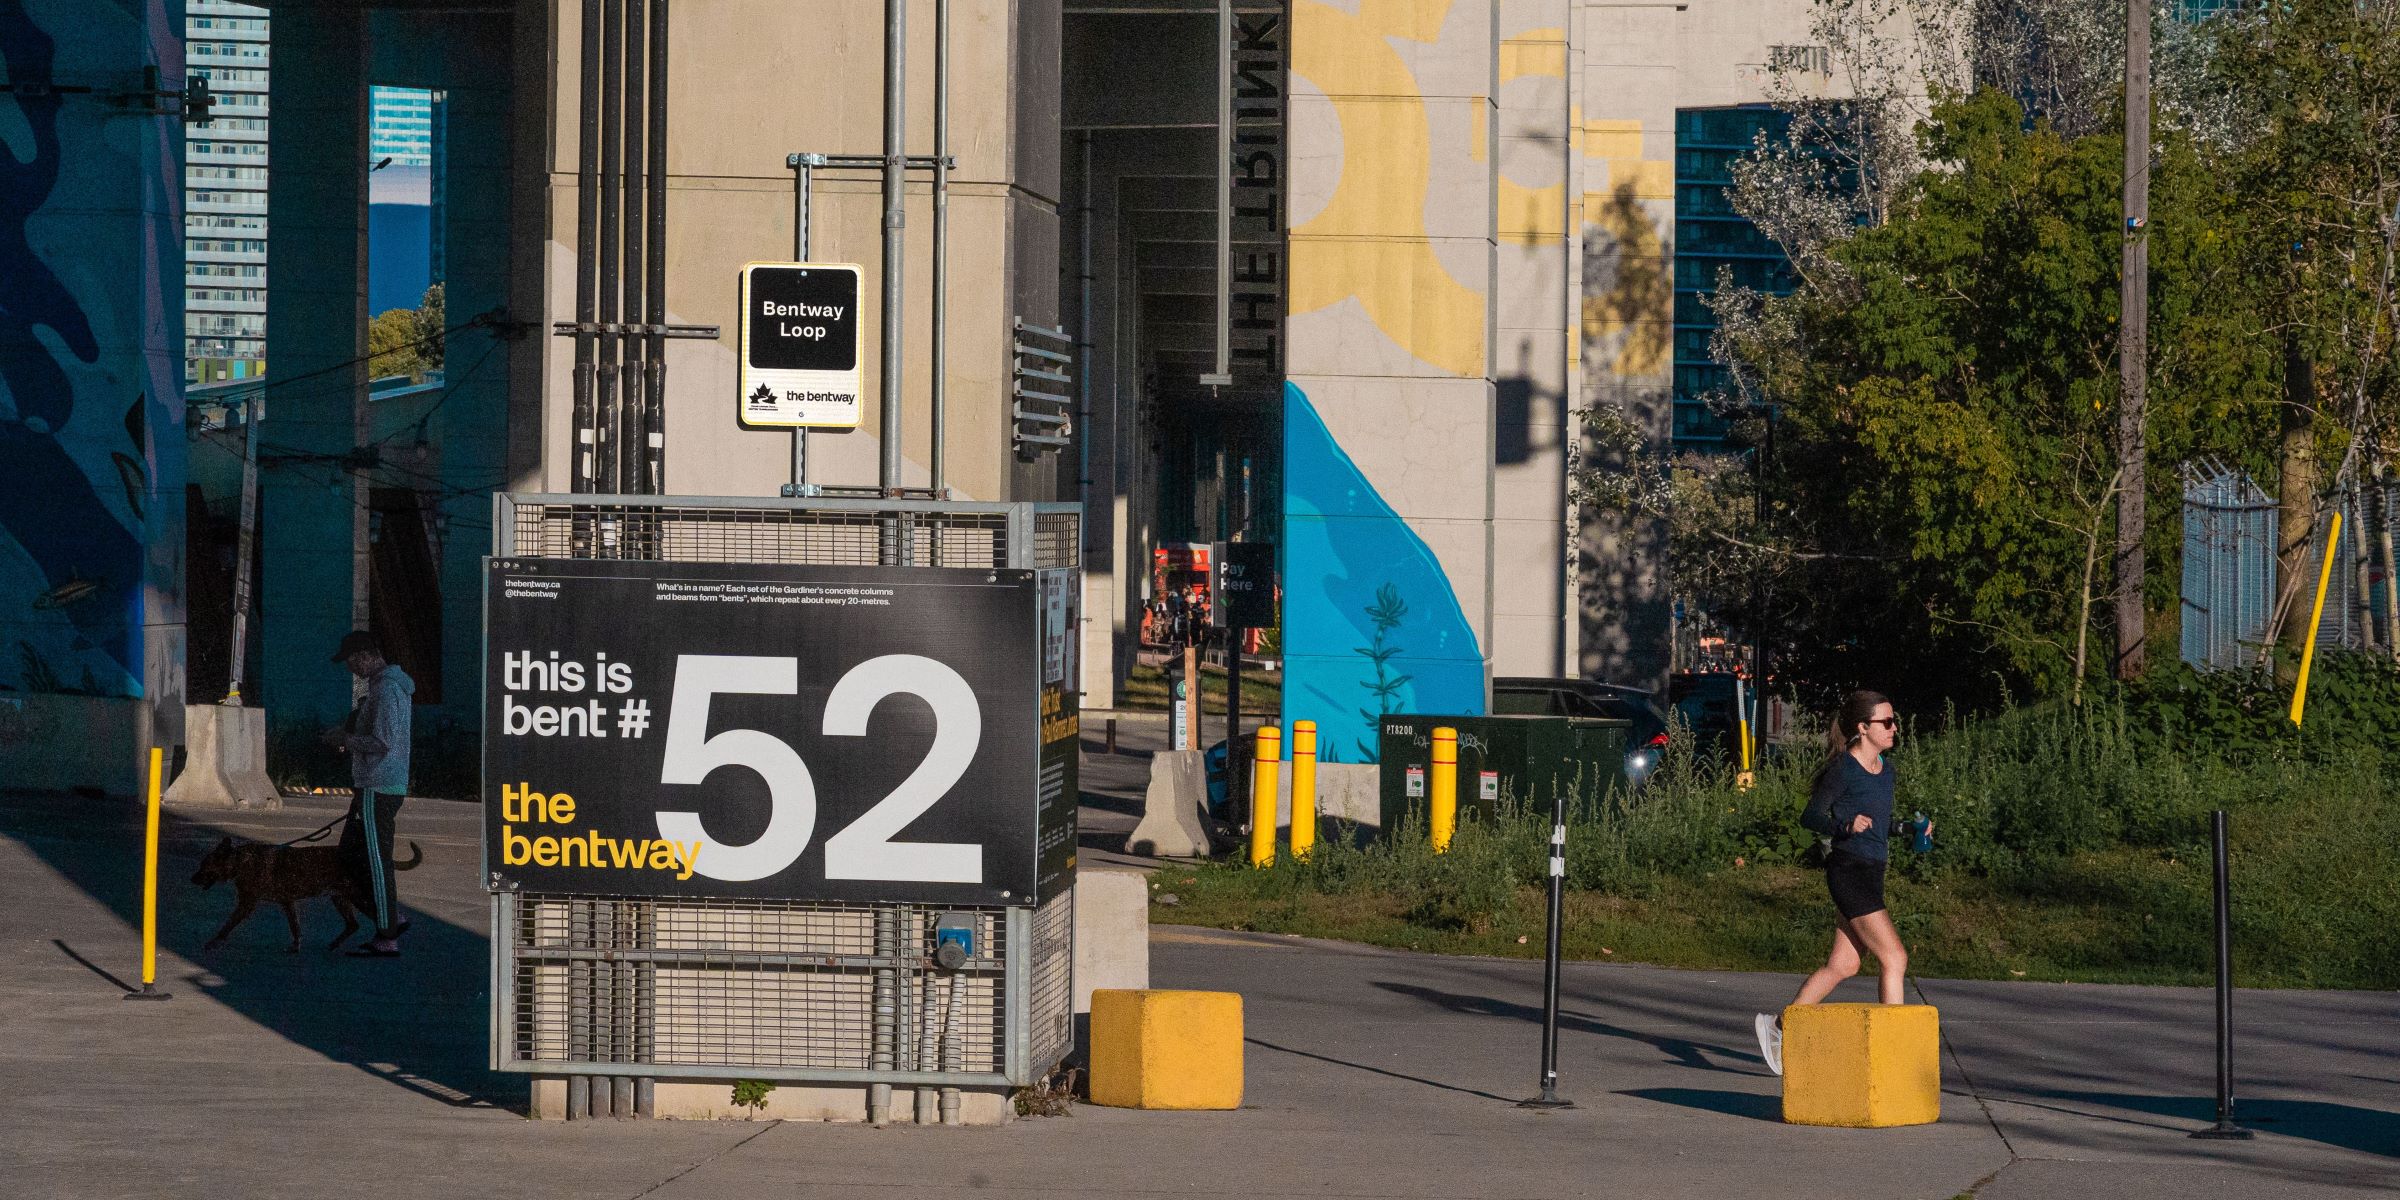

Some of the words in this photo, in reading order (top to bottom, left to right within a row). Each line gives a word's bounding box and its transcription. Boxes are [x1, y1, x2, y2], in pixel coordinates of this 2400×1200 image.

[763, 301, 844, 321] Bentway
[780, 322, 826, 341] Loop
[786, 390, 805, 401] the
[807, 390, 856, 405] bentway
[1220, 561, 1246, 577] Pay
[505, 579, 561, 590] thebentway.ca
[684, 583, 692, 592] in
[699, 584, 726, 593] name?
[726, 584, 746, 593] Each
[760, 585, 769, 594] of
[769, 585, 783, 594] the
[825, 587, 860, 596] concrete
[860, 587, 895, 596] columns
[1220, 577, 1254, 591] Here
[505, 589, 559, 600] @thebentway
[656, 593, 671, 601] and
[672, 593, 699, 602] beams
[699, 593, 718, 602] form
[750, 595, 774, 603] which
[775, 596, 801, 605] repeat
[801, 596, 825, 604] about
[825, 598, 847, 606] every
[848, 597, 891, 606] 20-metres.
[504, 650, 586, 692] this
[596, 652, 633, 693] is
[503, 694, 607, 738] bent
[617, 698, 651, 739] #
[655, 653, 983, 884] 52
[502, 782, 576, 823] the
[503, 825, 703, 881] bentway
